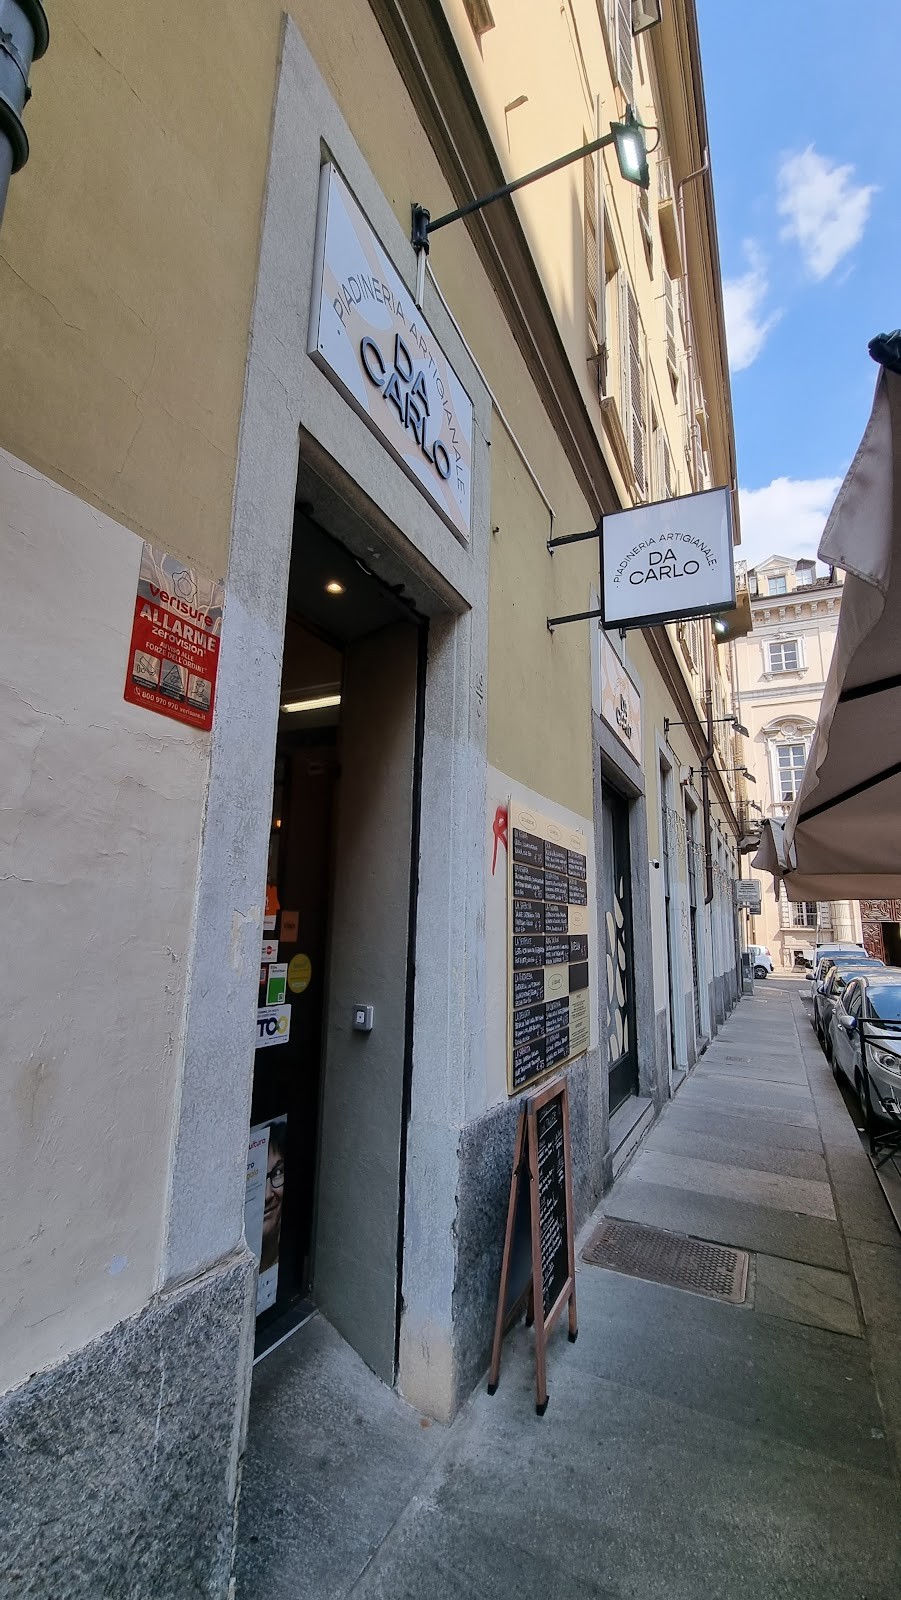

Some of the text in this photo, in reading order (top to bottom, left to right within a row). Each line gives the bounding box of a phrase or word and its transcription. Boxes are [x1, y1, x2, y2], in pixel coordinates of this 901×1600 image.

[332, 275, 467, 495] PIADINERIA ARTIGIANALE
[394, 333, 430, 417] DA
[360, 336, 451, 480] CARLO
[613, 532, 718, 583] PIADINERIA ARTIGIANALE
[629, 560, 700, 585] CARLO
[649, 548, 677, 566] DA
[140, 603, 217, 653] ALLARME
[149, 583, 214, 627] verisure
[145, 641, 167, 657] FORZE
[141, 690, 155, 703] 800
